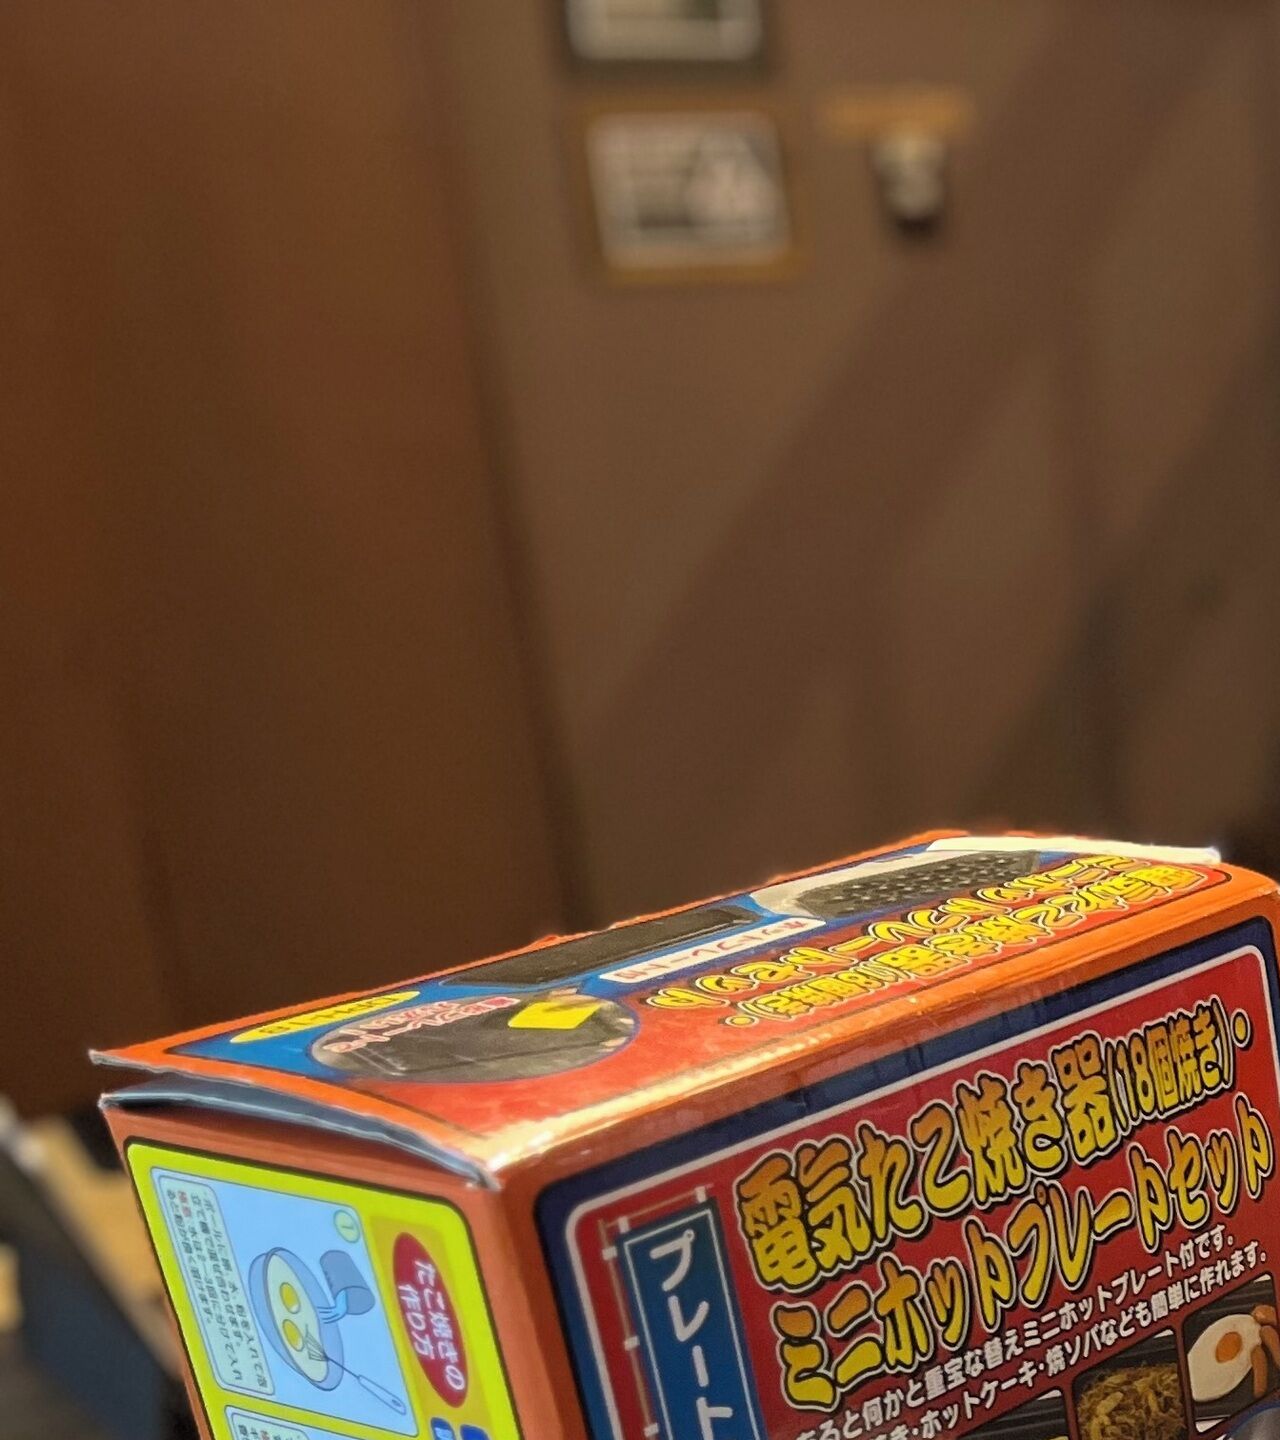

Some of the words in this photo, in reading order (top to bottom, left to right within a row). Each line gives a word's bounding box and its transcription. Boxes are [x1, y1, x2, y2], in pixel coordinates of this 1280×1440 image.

[396, 1281, 436, 1361] 作り方
[769, 1098, 1275, 1412] ミニホットプレートセット
[413, 1259, 469, 1394] たこ焼きの
